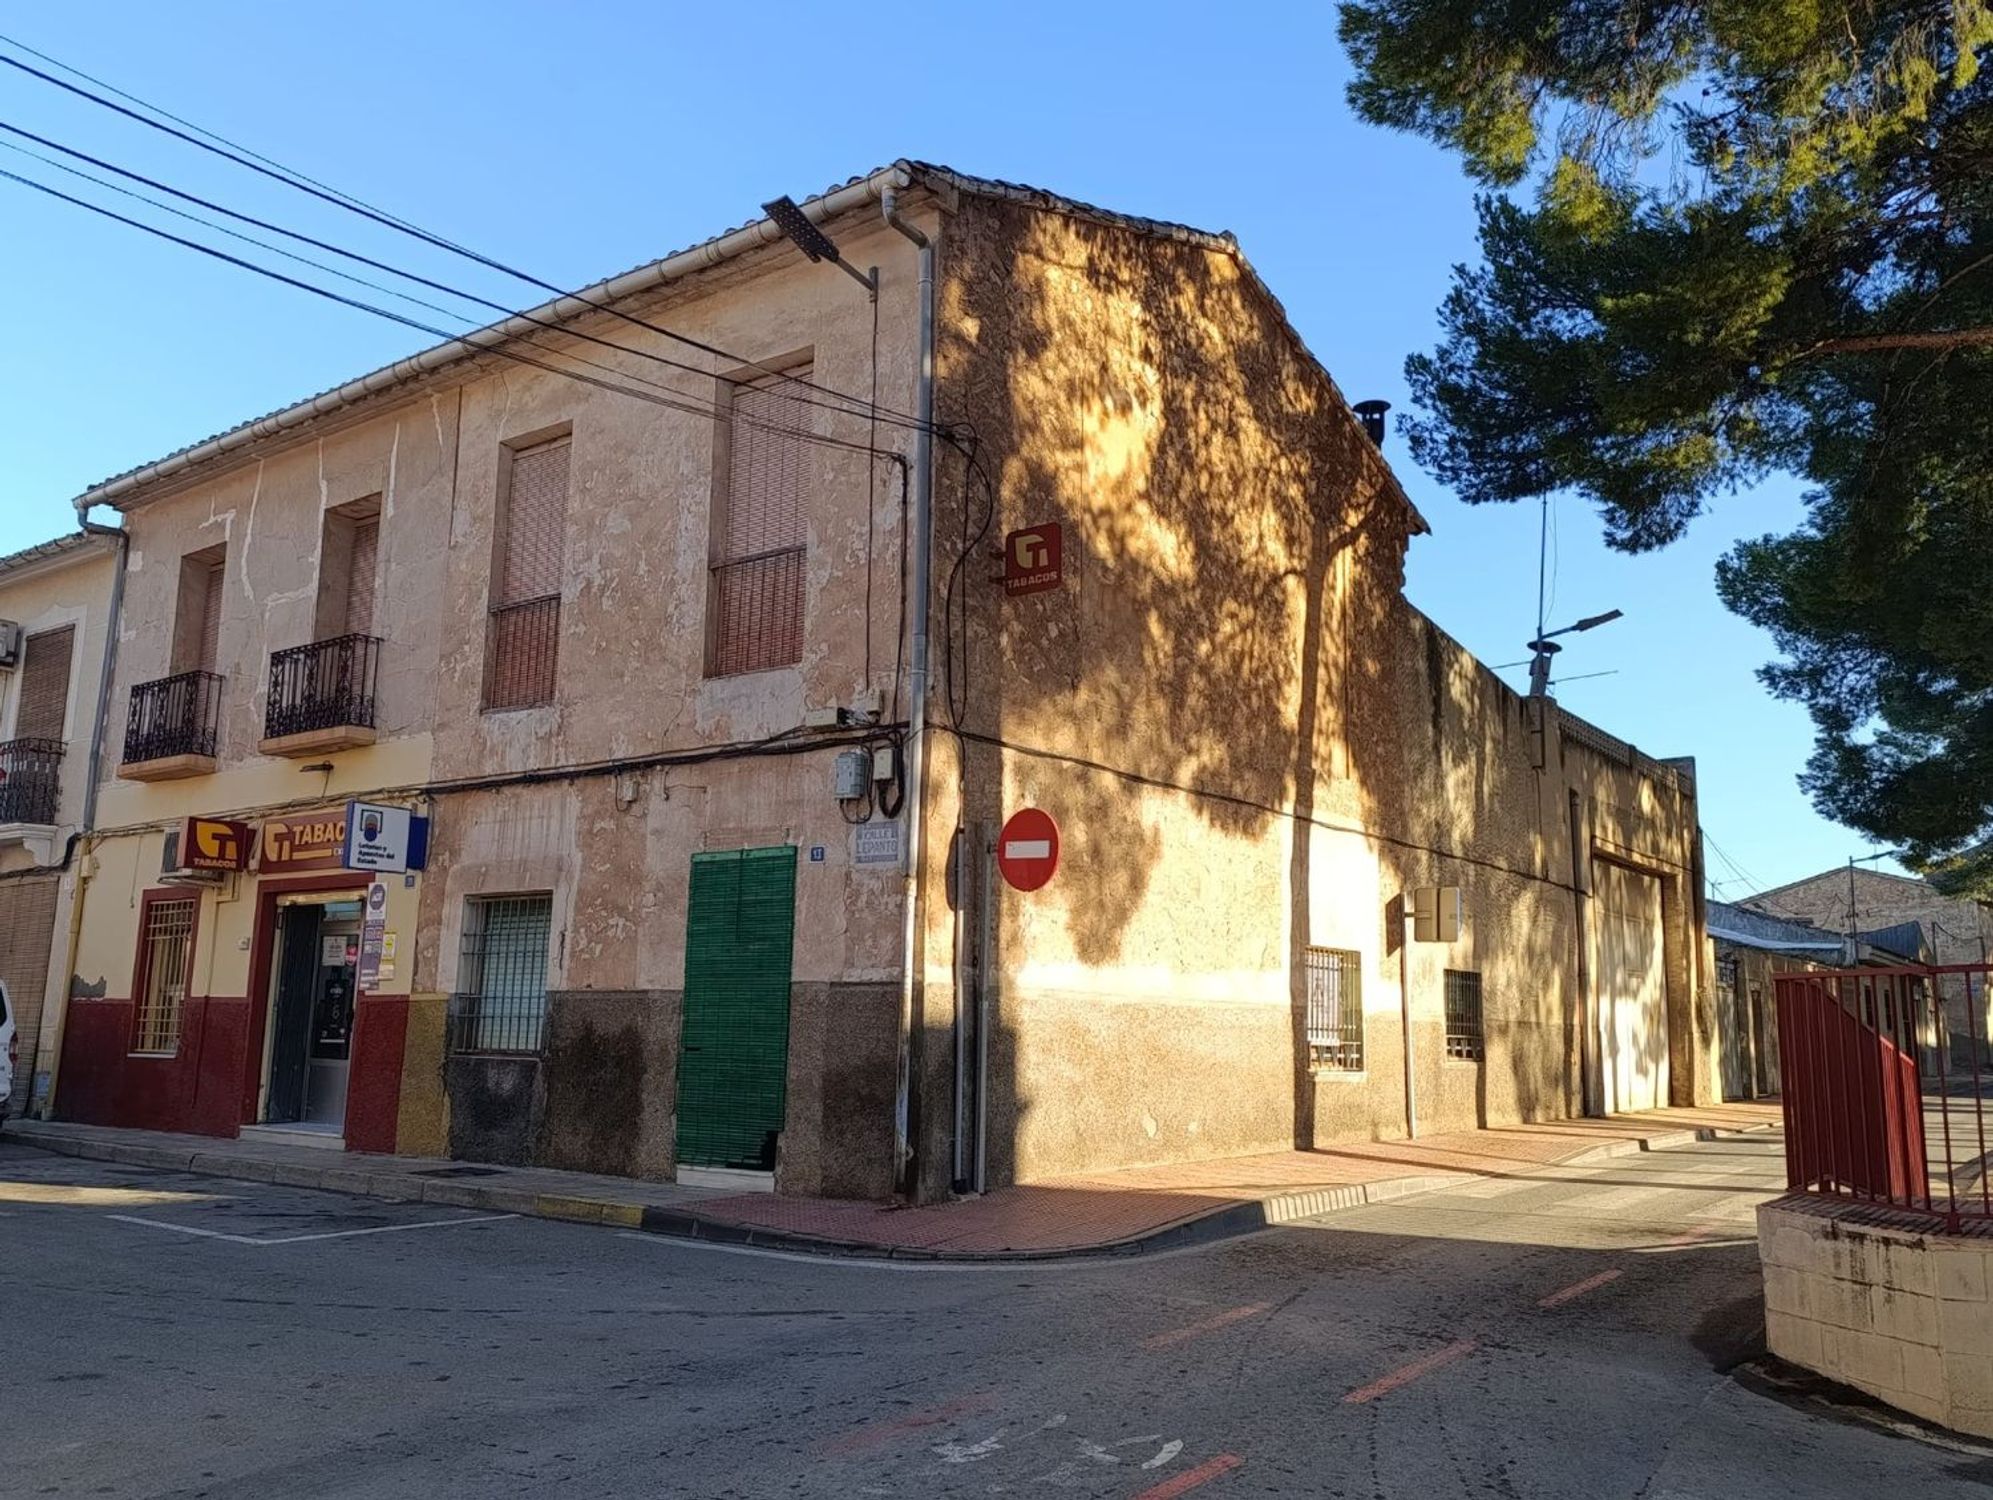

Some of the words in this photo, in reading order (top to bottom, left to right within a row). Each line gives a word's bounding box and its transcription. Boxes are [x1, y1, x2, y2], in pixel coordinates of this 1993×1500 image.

[1007, 571, 1058, 588] TABACOS
[856, 840, 897, 854] LEPANTO
[193, 857, 237, 869] TABACOS
